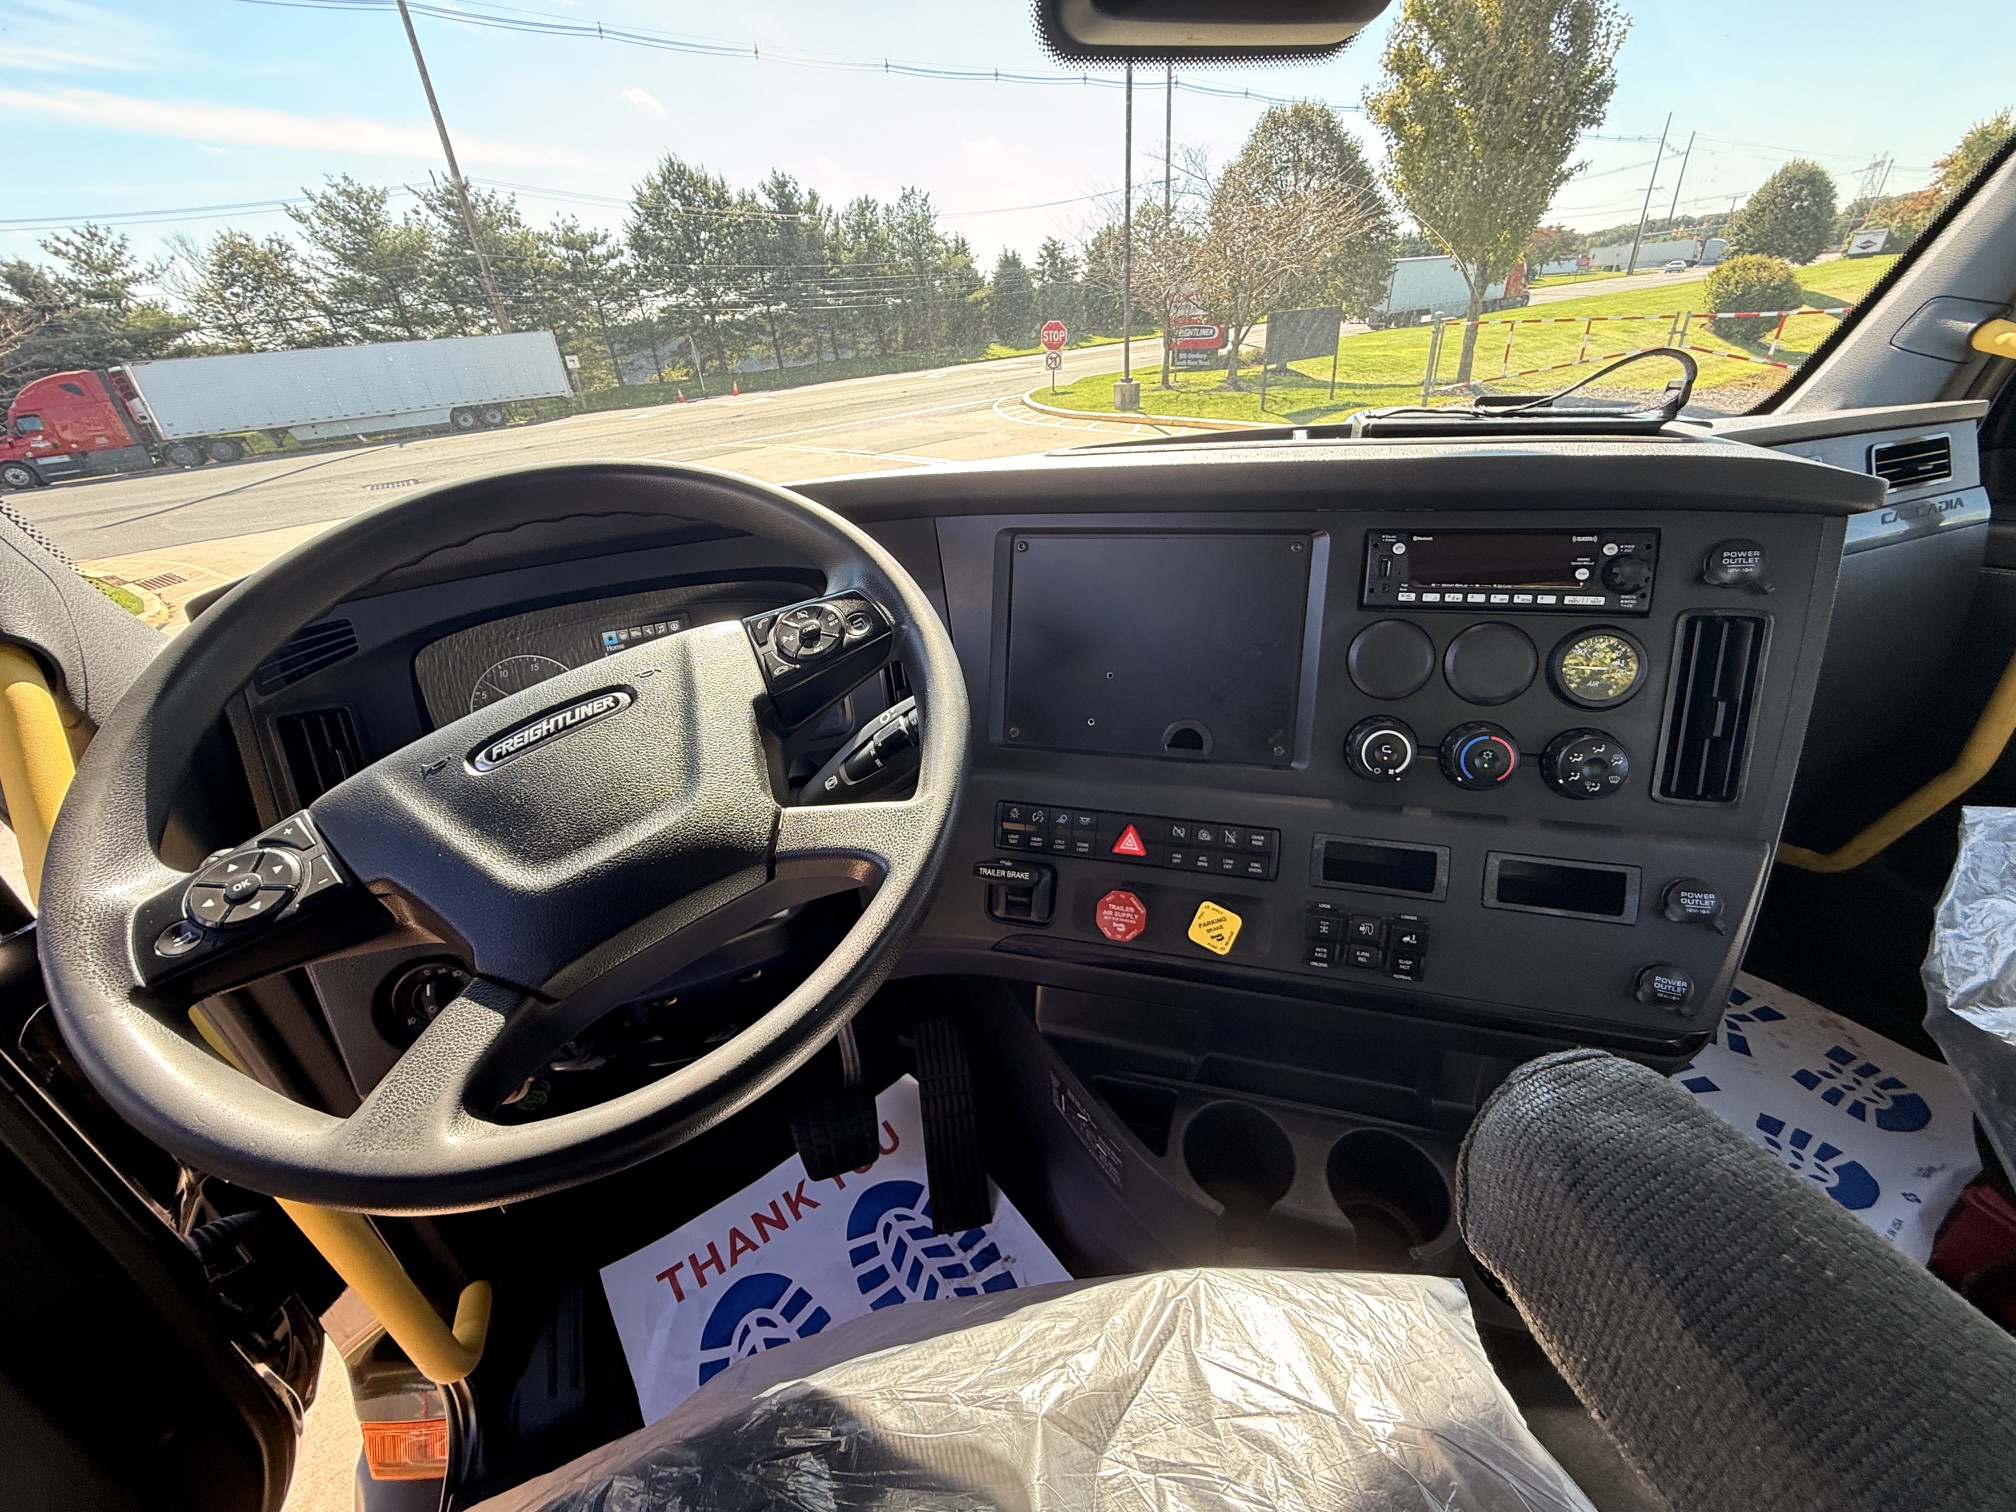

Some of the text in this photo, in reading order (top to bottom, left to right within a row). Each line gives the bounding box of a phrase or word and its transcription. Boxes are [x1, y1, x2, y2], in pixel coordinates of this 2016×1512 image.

[1043, 330, 1065, 342] STOP
[1881, 497, 1954, 525] CACADIA
[1722, 557, 1760, 565] OUTLET
[606, 643, 625, 652] Home
[530, 663, 540, 672] 15
[499, 669, 509, 678] 10
[481, 691, 488, 700] 5
[491, 696, 617, 760] FREIGHTLINER
[979, 867, 1030, 880] TRAILER BRAKE
[232, 878, 251, 892] OK
[1680, 891, 1715, 900] POWER
[1680, 898, 1716, 906] OUTLET
[1108, 903, 1134, 913] TRAILER
[1114, 910, 1139, 920] SUPPLY
[1198, 916, 1227, 929] PARKING
[1206, 925, 1224, 934] BRAKE
[1655, 976, 1688, 987] POWER
[1653, 982, 1687, 993] OUTLET
[656, 1179, 821, 1304] THANK
